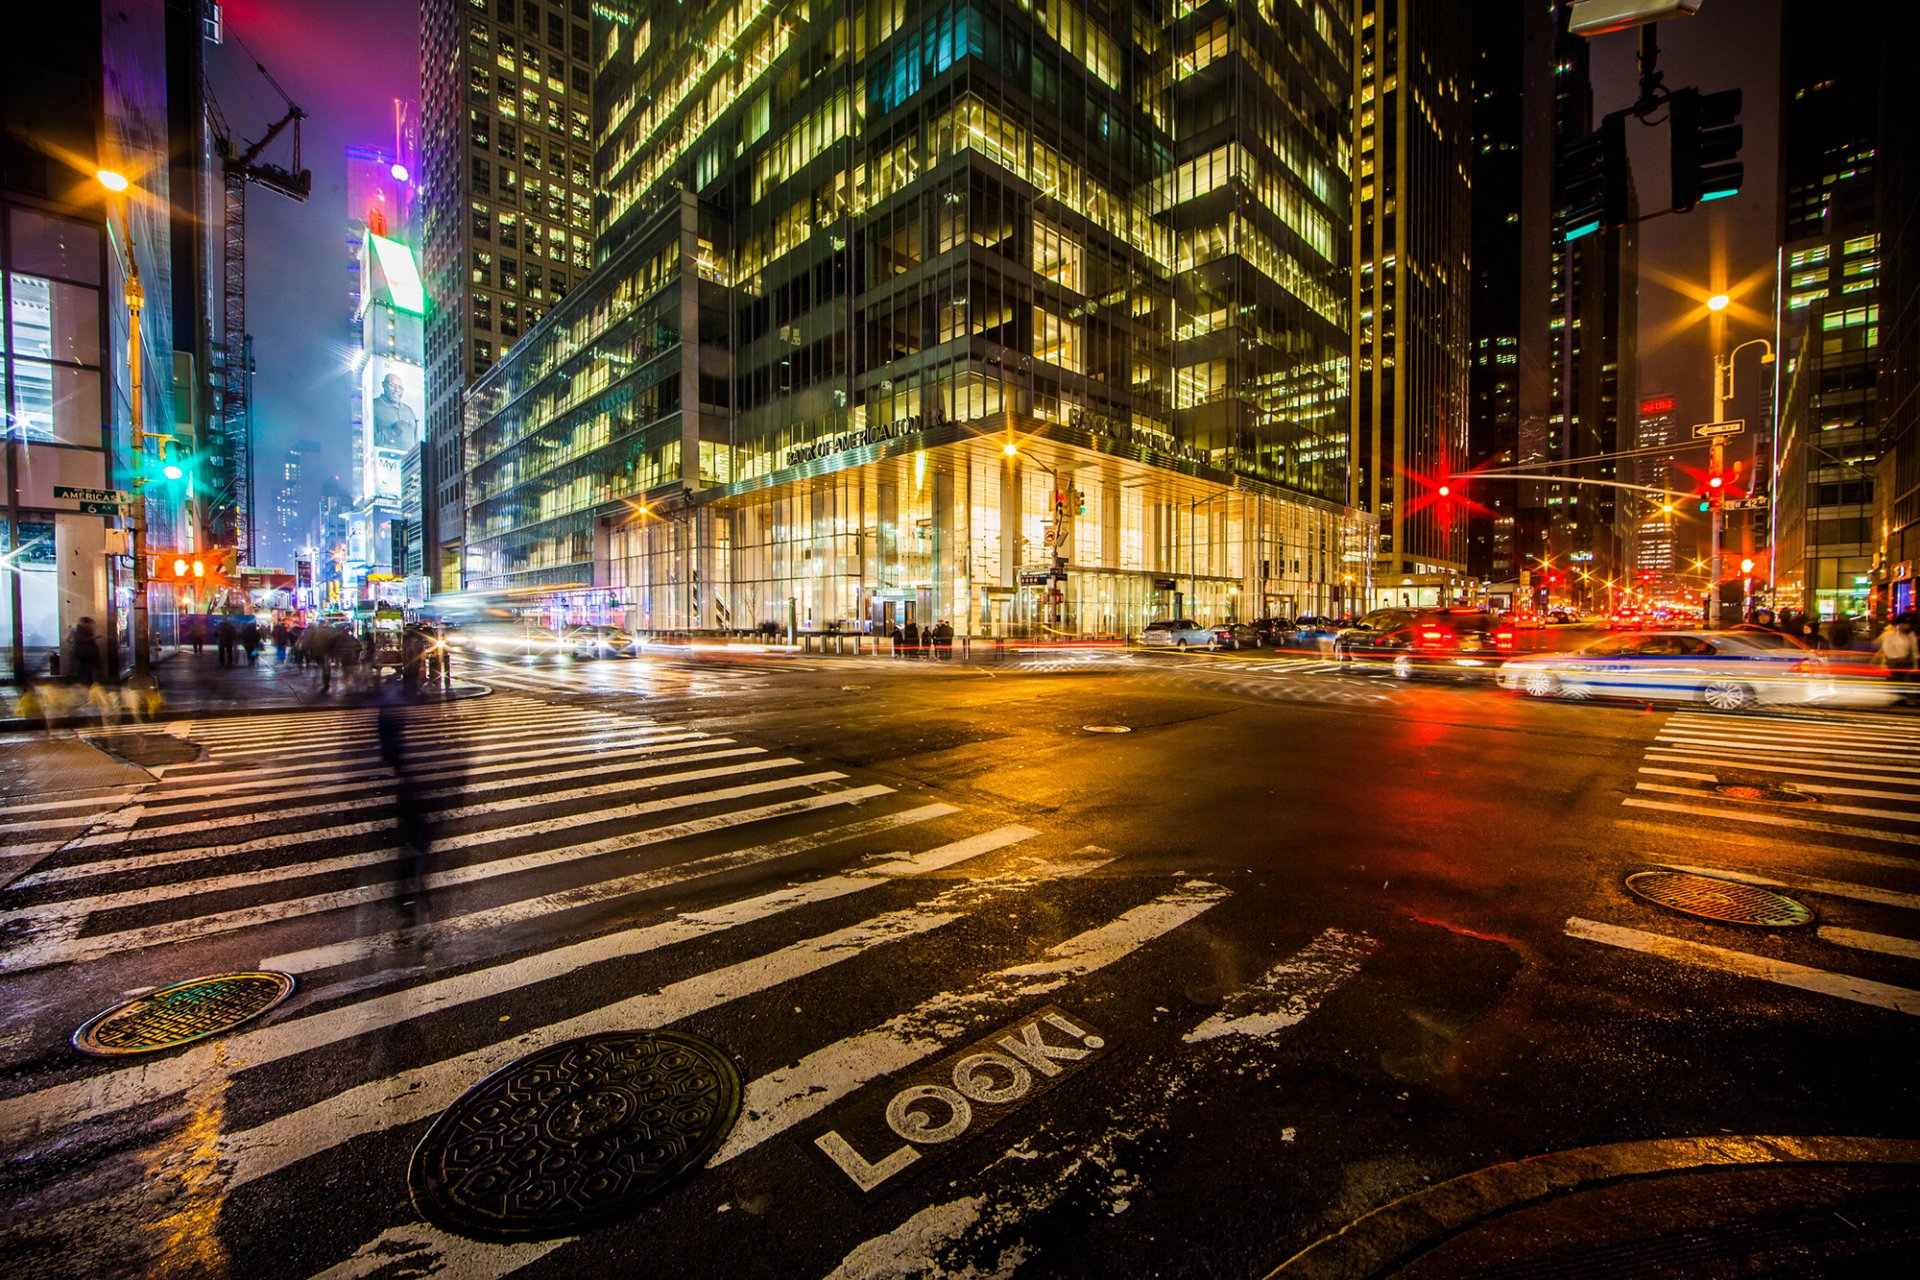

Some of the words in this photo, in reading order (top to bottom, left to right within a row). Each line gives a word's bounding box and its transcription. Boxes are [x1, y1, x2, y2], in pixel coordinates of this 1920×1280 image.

[786, 444, 817, 466] BANK
[817, 440, 834, 457] OF
[834, 423, 890, 454] AMERICA
[62, 490, 116, 502] AMERICAS
[88, 504, 97, 514] 6
[1745, 500, 1758, 508] 42
[814, 1012, 1105, 1193] LOOK!
